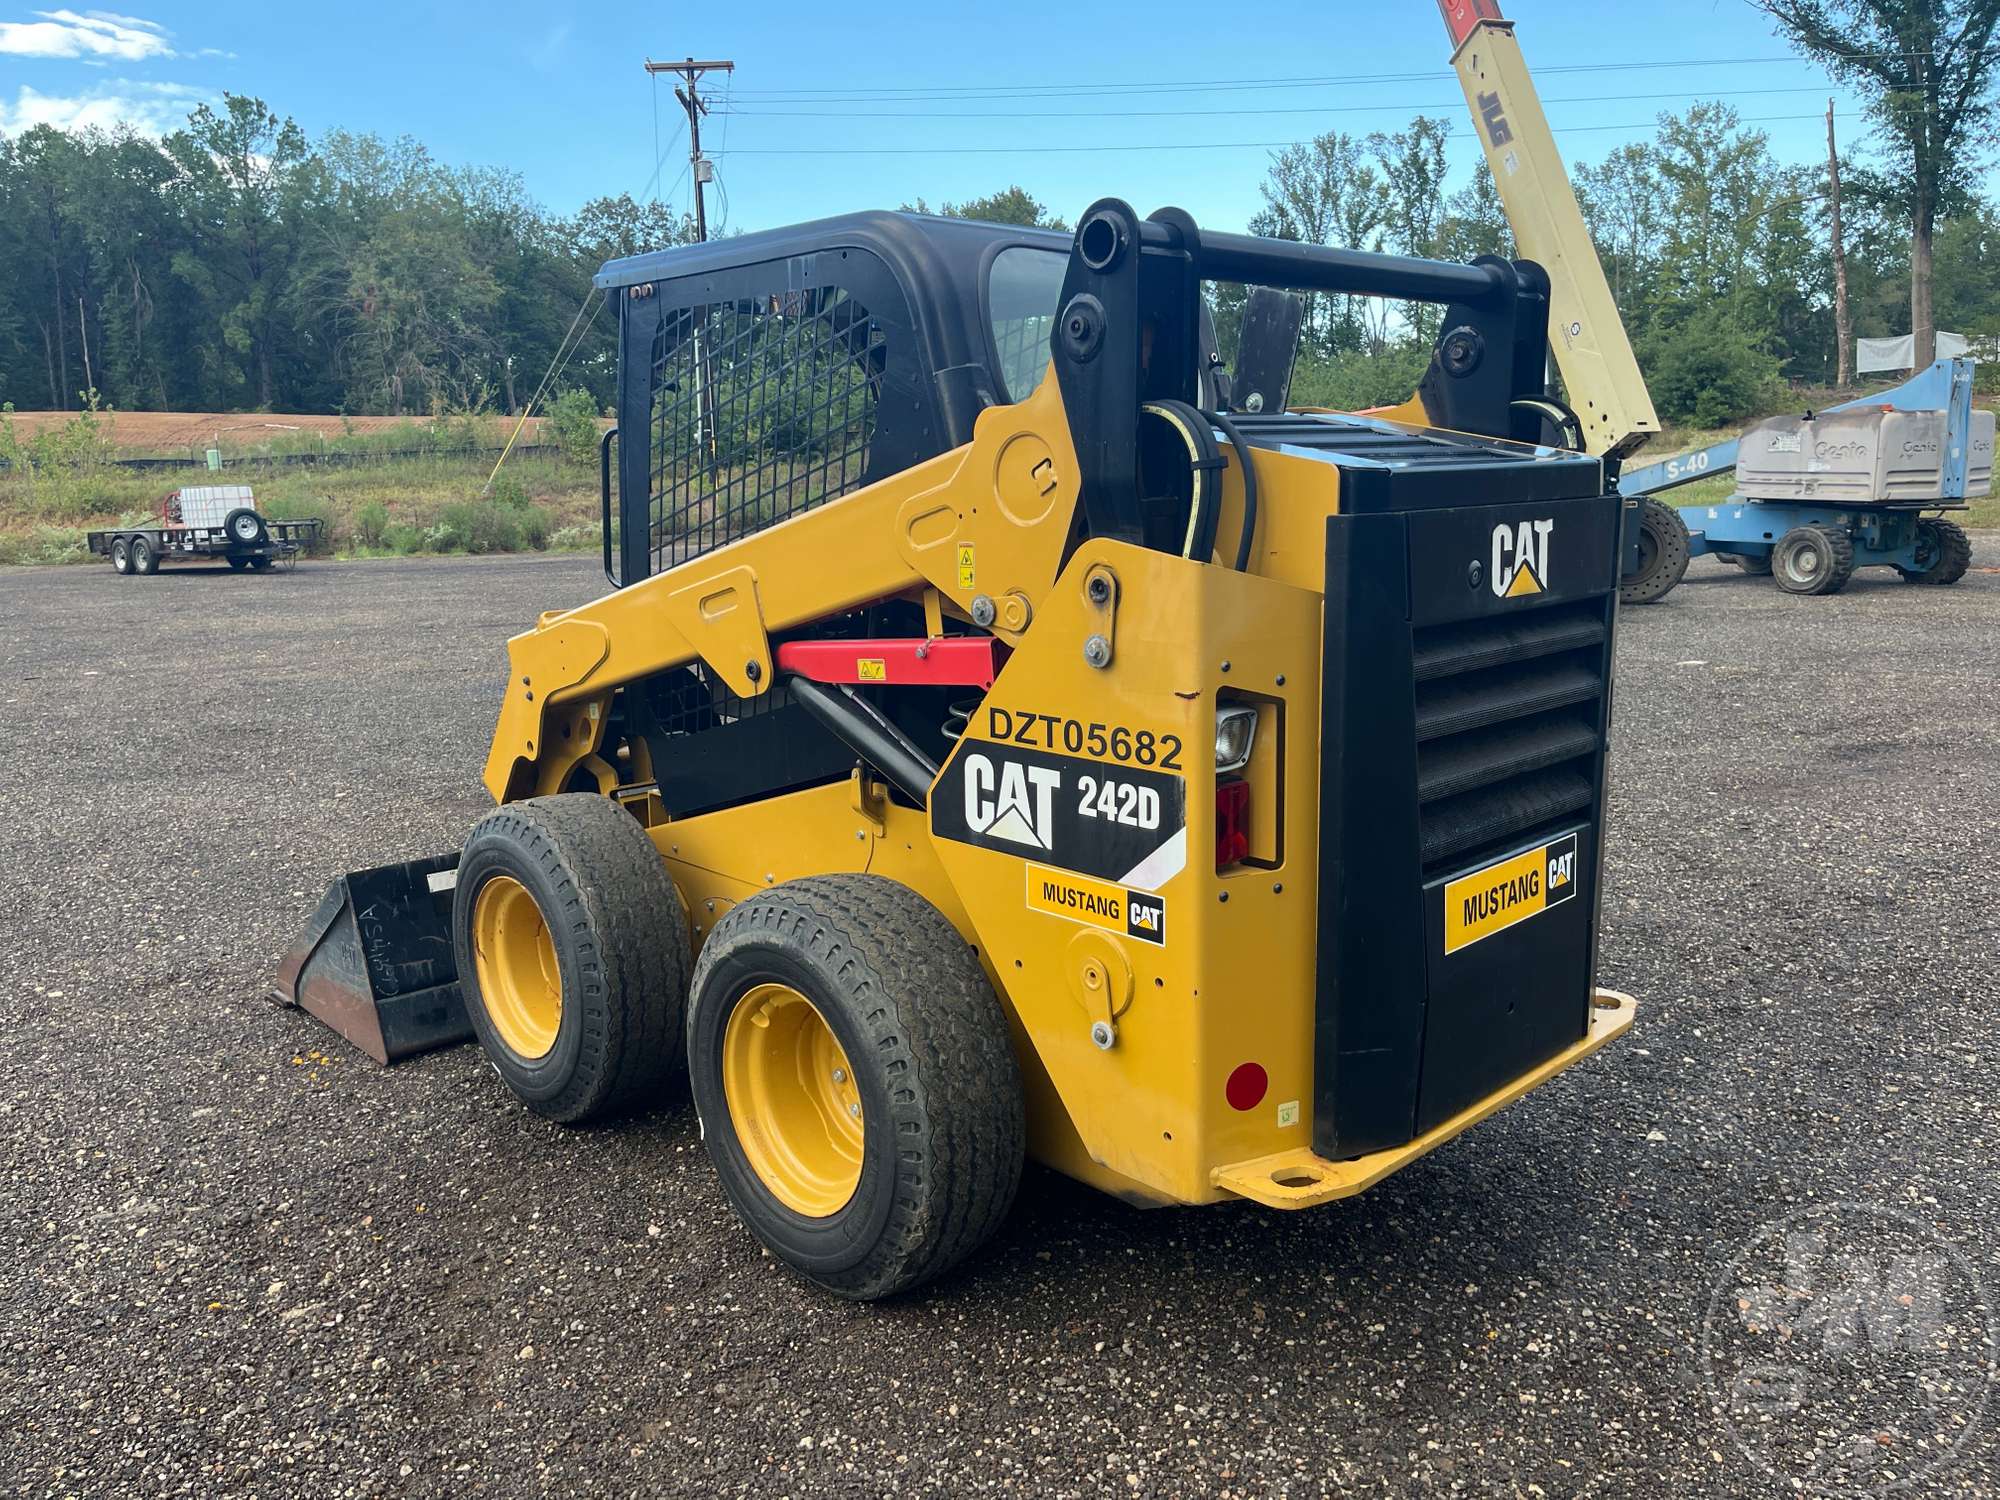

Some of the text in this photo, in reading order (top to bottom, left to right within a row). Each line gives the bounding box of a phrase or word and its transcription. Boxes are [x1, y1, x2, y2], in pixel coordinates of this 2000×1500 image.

[1667, 451, 1709, 480] S-40
[1814, 440, 1868, 460] Genie
[1903, 440, 1938, 454] Genie
[1491, 517, 1554, 599] CAT
[989, 707, 1182, 769] DZT05682
[964, 753, 1160, 851] CAT 242D
[1042, 881, 1162, 931] MUSTANG CAT
[1462, 850, 1573, 927] MUSTANG CAT
